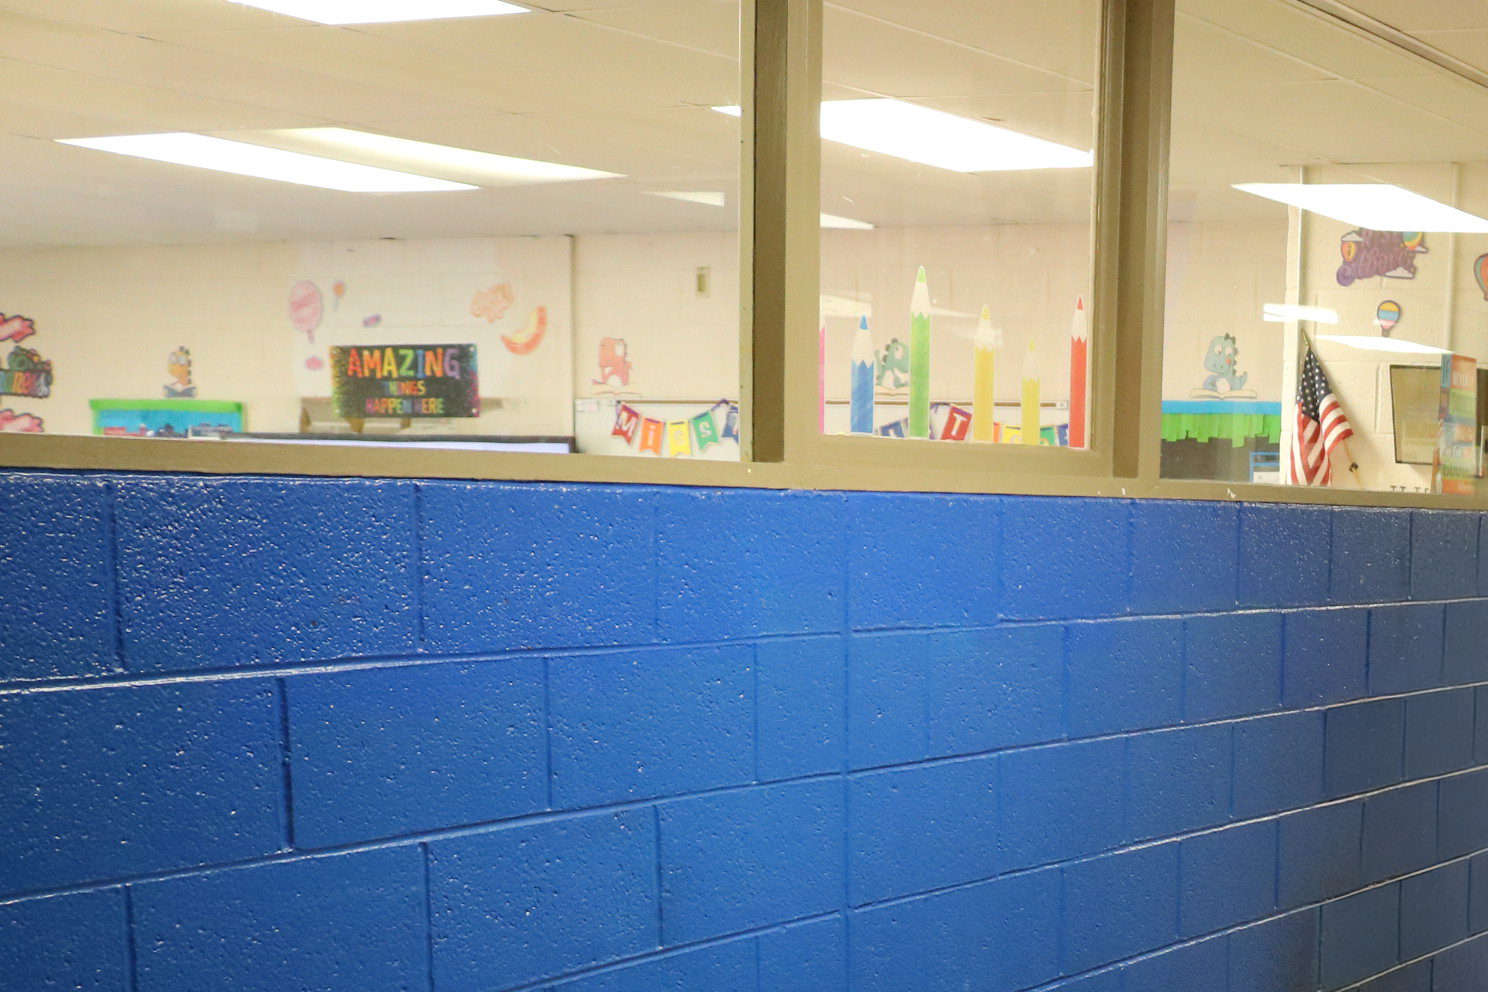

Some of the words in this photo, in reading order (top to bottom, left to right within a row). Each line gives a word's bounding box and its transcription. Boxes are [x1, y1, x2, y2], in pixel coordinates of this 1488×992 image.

[347, 347, 461, 379] AMAZING
[380, 380, 427, 396] THINGS
[366, 398, 413, 415] HAPPEN
[414, 398, 445, 415] HERE
